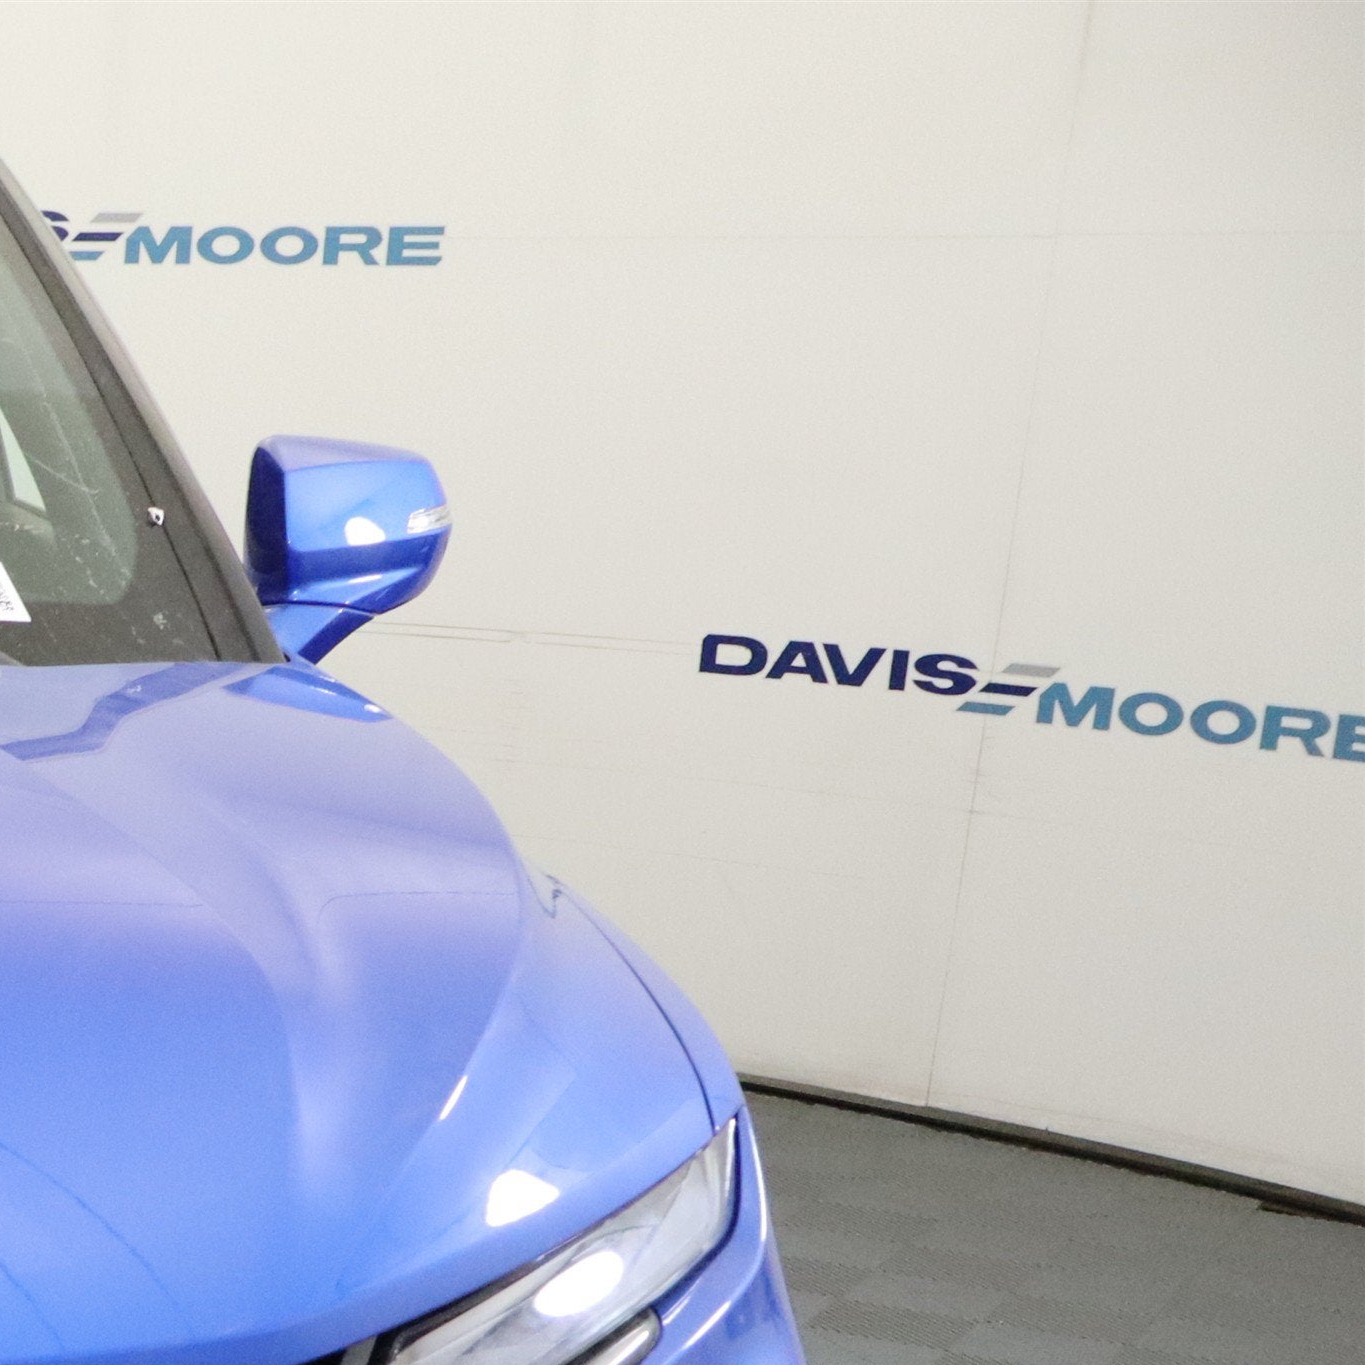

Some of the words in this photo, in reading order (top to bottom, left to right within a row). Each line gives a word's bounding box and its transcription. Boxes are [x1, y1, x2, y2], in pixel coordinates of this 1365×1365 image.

[123, 225, 446, 267] MOORE
[698, 632, 978, 696] DAVIS
[1034, 681, 1365, 763] MOORE
